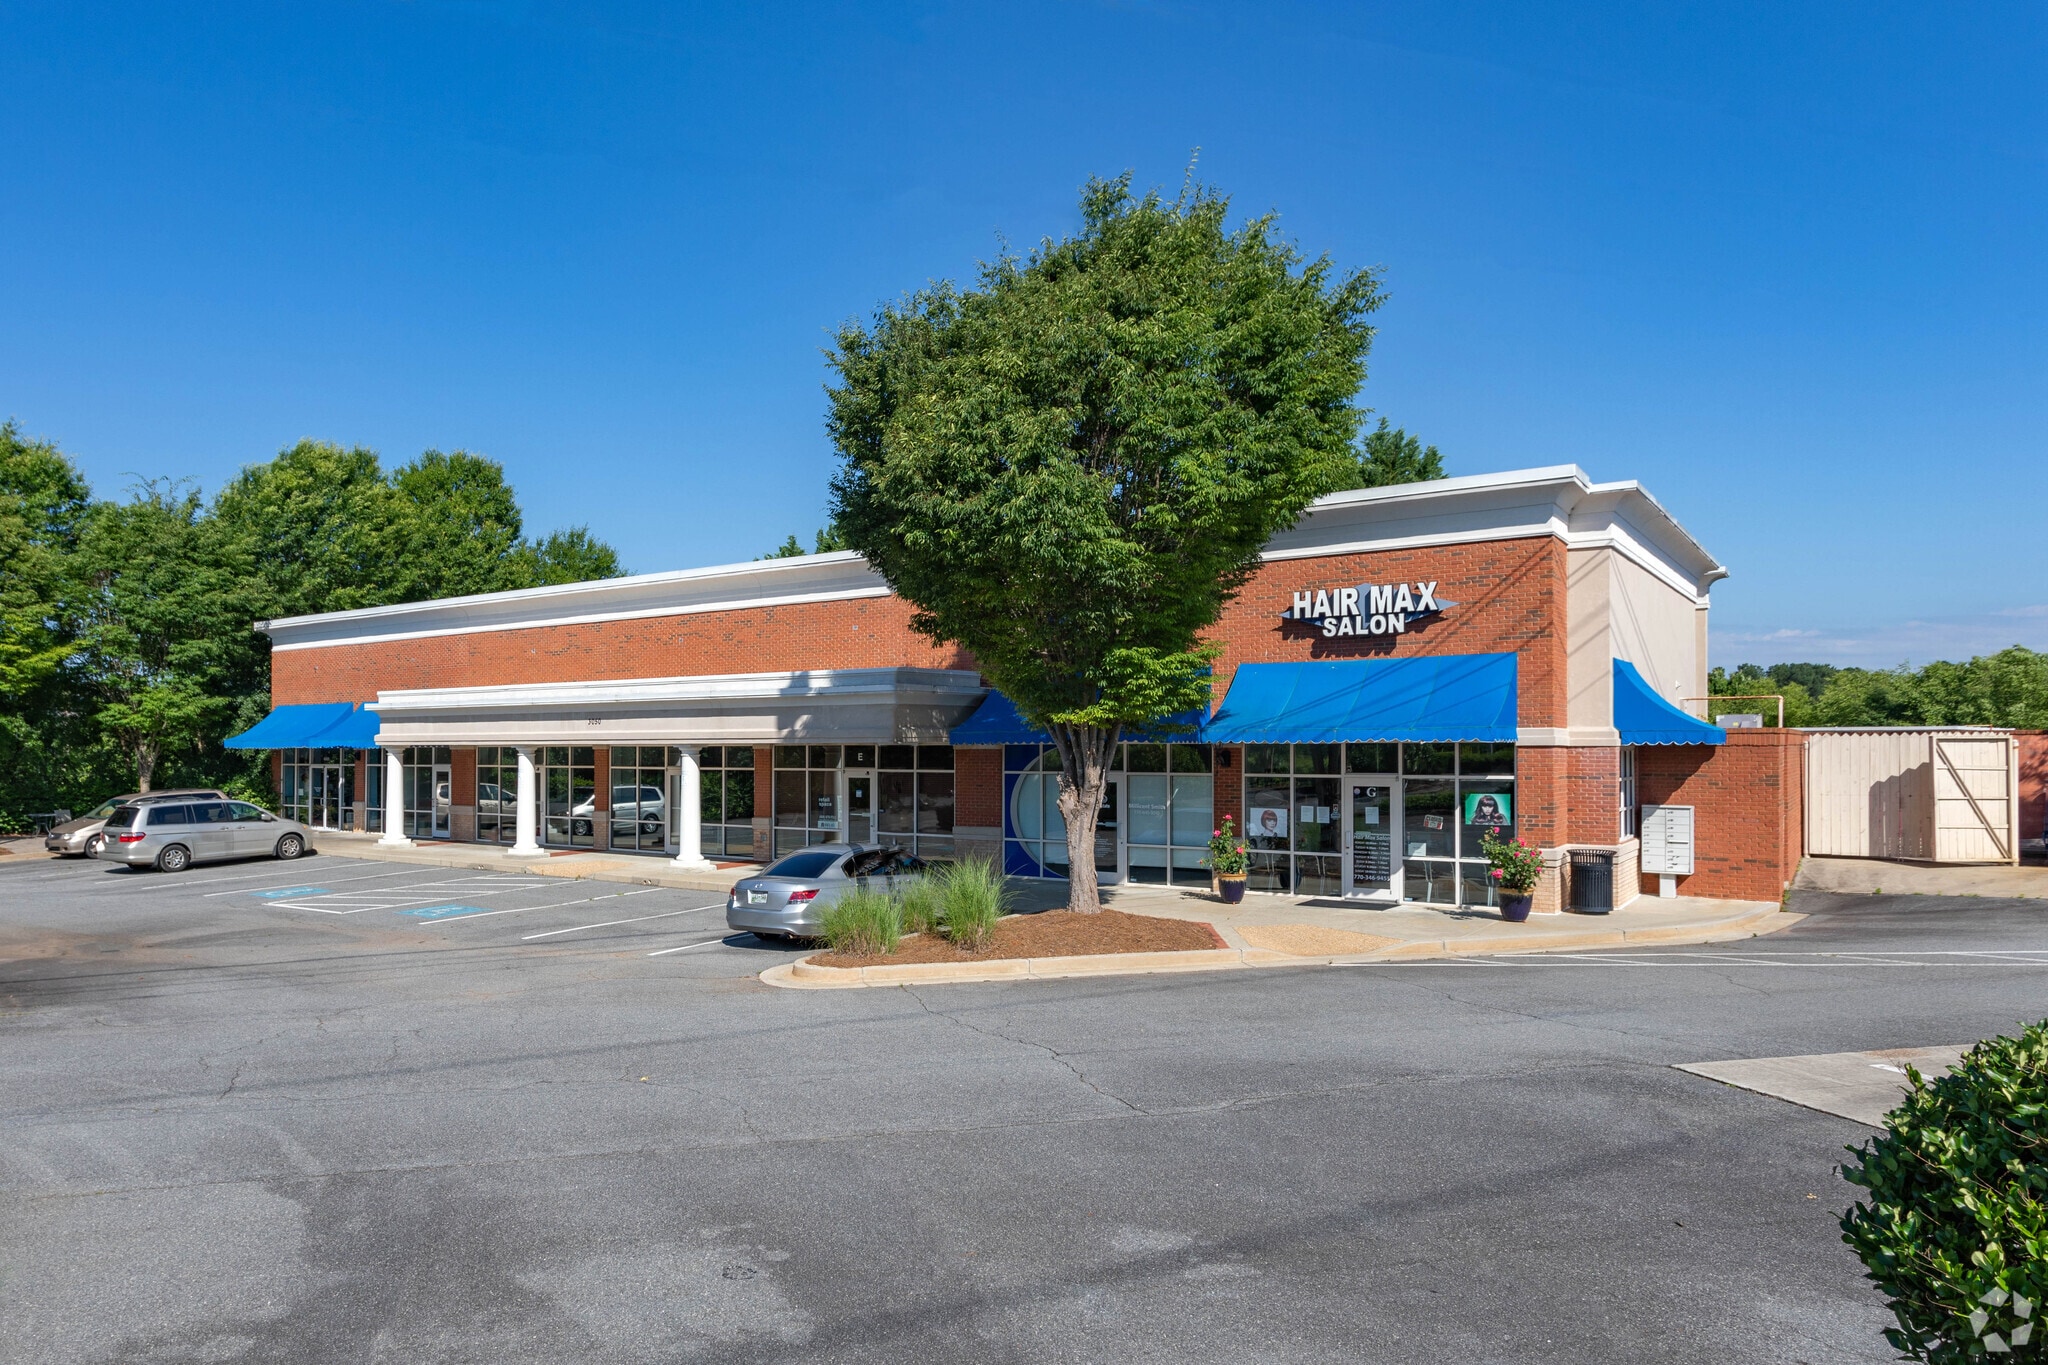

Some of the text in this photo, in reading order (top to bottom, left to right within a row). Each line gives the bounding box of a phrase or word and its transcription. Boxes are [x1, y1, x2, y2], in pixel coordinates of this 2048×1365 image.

[1293, 581, 1440, 619] HAIR MAX
[1322, 613, 1405, 637] SALON
[857, 752, 863, 761] E
[1366, 787, 1377, 798] G
